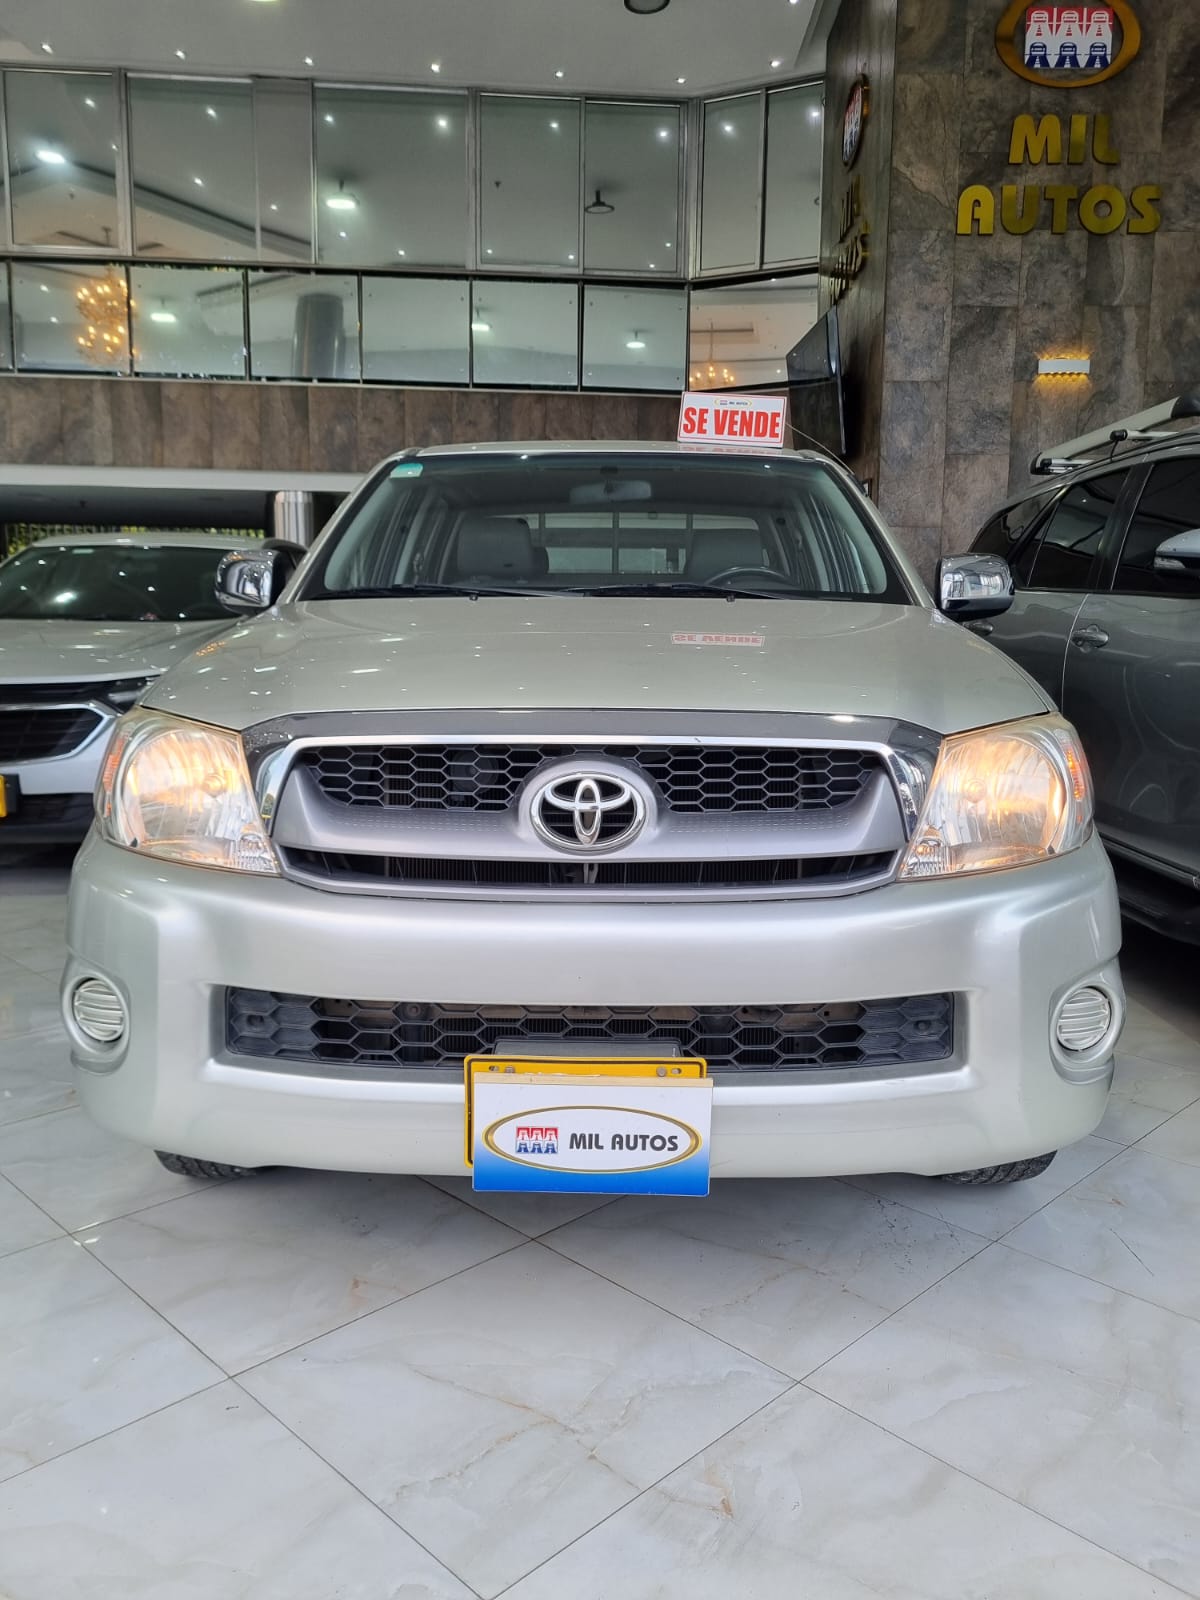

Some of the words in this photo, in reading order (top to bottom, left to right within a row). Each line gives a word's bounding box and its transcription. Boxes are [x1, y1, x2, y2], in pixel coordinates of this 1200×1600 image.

[1009, 113, 1120, 165] MIL
[956, 184, 1161, 235] AUTOS
[683, 407, 708, 434] SE
[714, 409, 780, 438] VENDE
[569, 1133, 603, 1149] MIL
[611, 1134, 678, 1151] AUTOS
